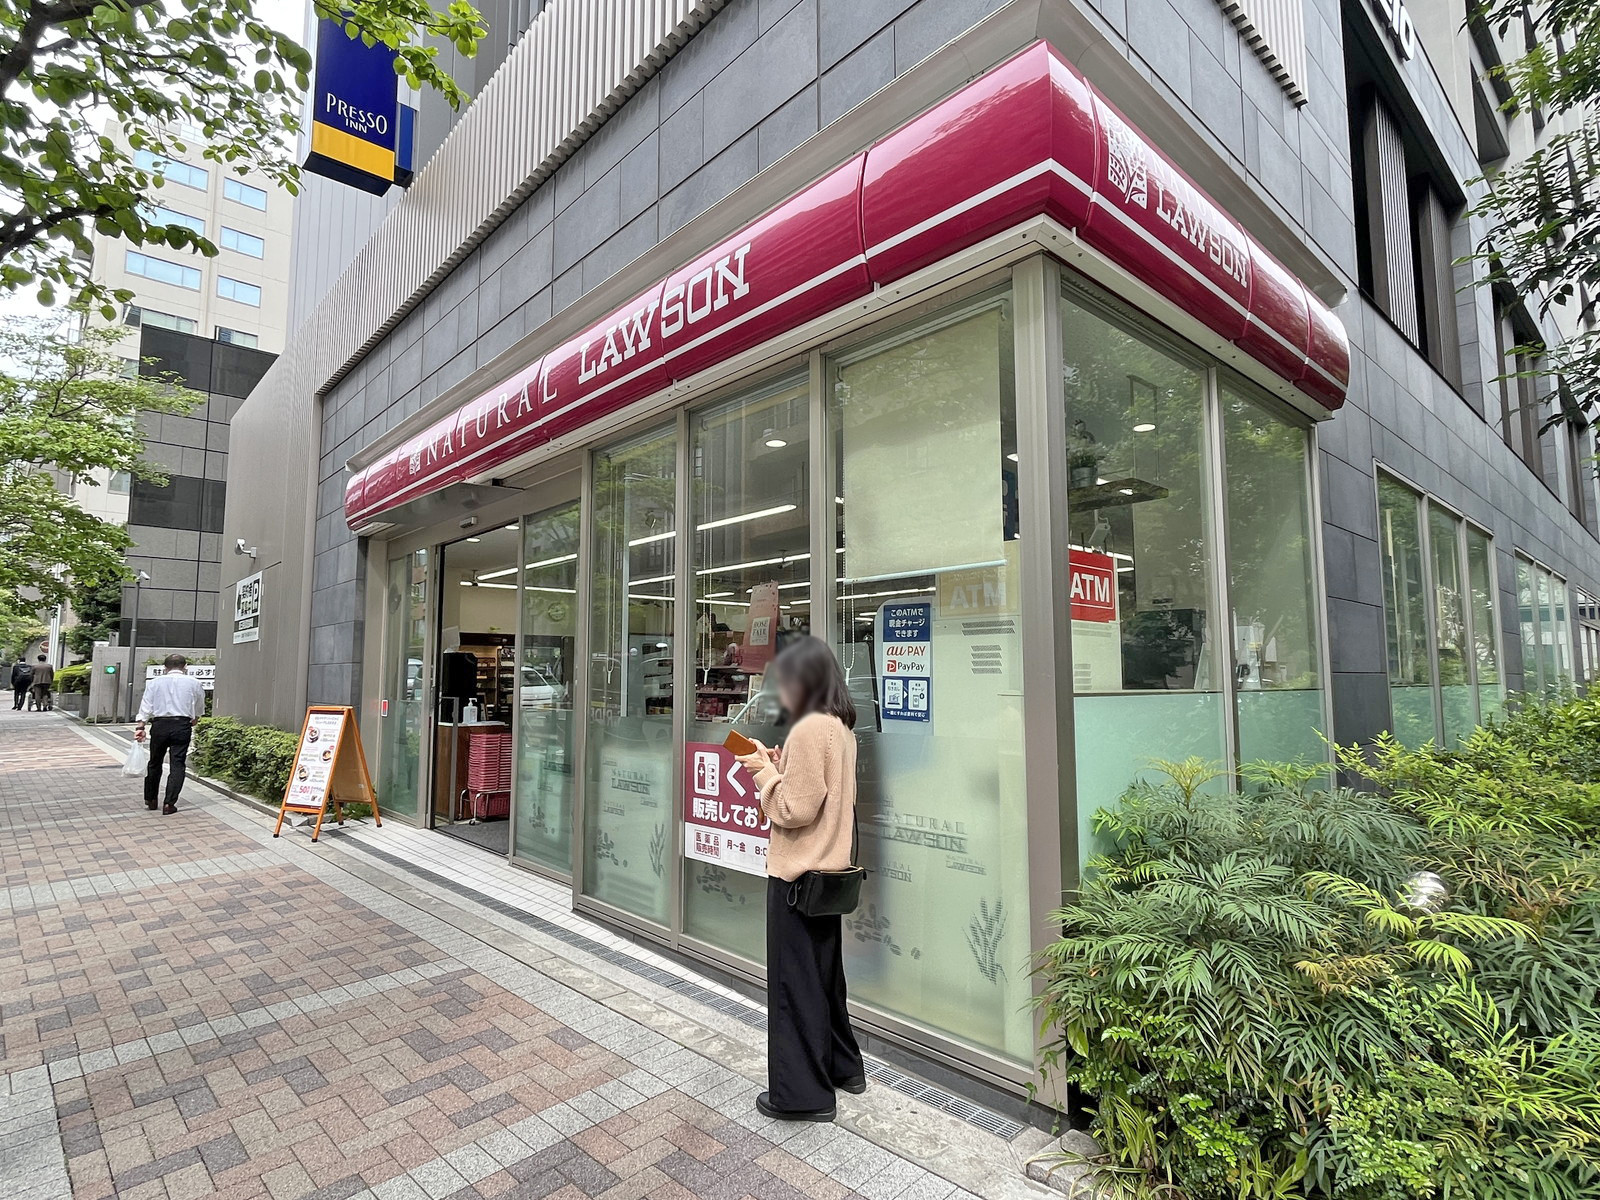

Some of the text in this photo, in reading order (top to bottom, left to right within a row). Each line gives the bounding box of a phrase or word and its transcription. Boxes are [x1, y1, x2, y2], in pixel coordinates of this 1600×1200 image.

[326, 92, 388, 135] PRESSO
[345, 116, 368, 134] INN
[1156, 181, 1249, 288] LAWSON
[426, 242, 751, 467] NATURAL LAWSON
[950, 580, 1007, 609] ATM
[1070, 572, 1110, 603] ATM
[890, 608, 924, 617] このATMで
[888, 618, 925, 628] 現金チャージ
[894, 629, 919, 638] できます
[907, 645, 926, 657] PAY
[897, 661, 925, 673] PayPay
